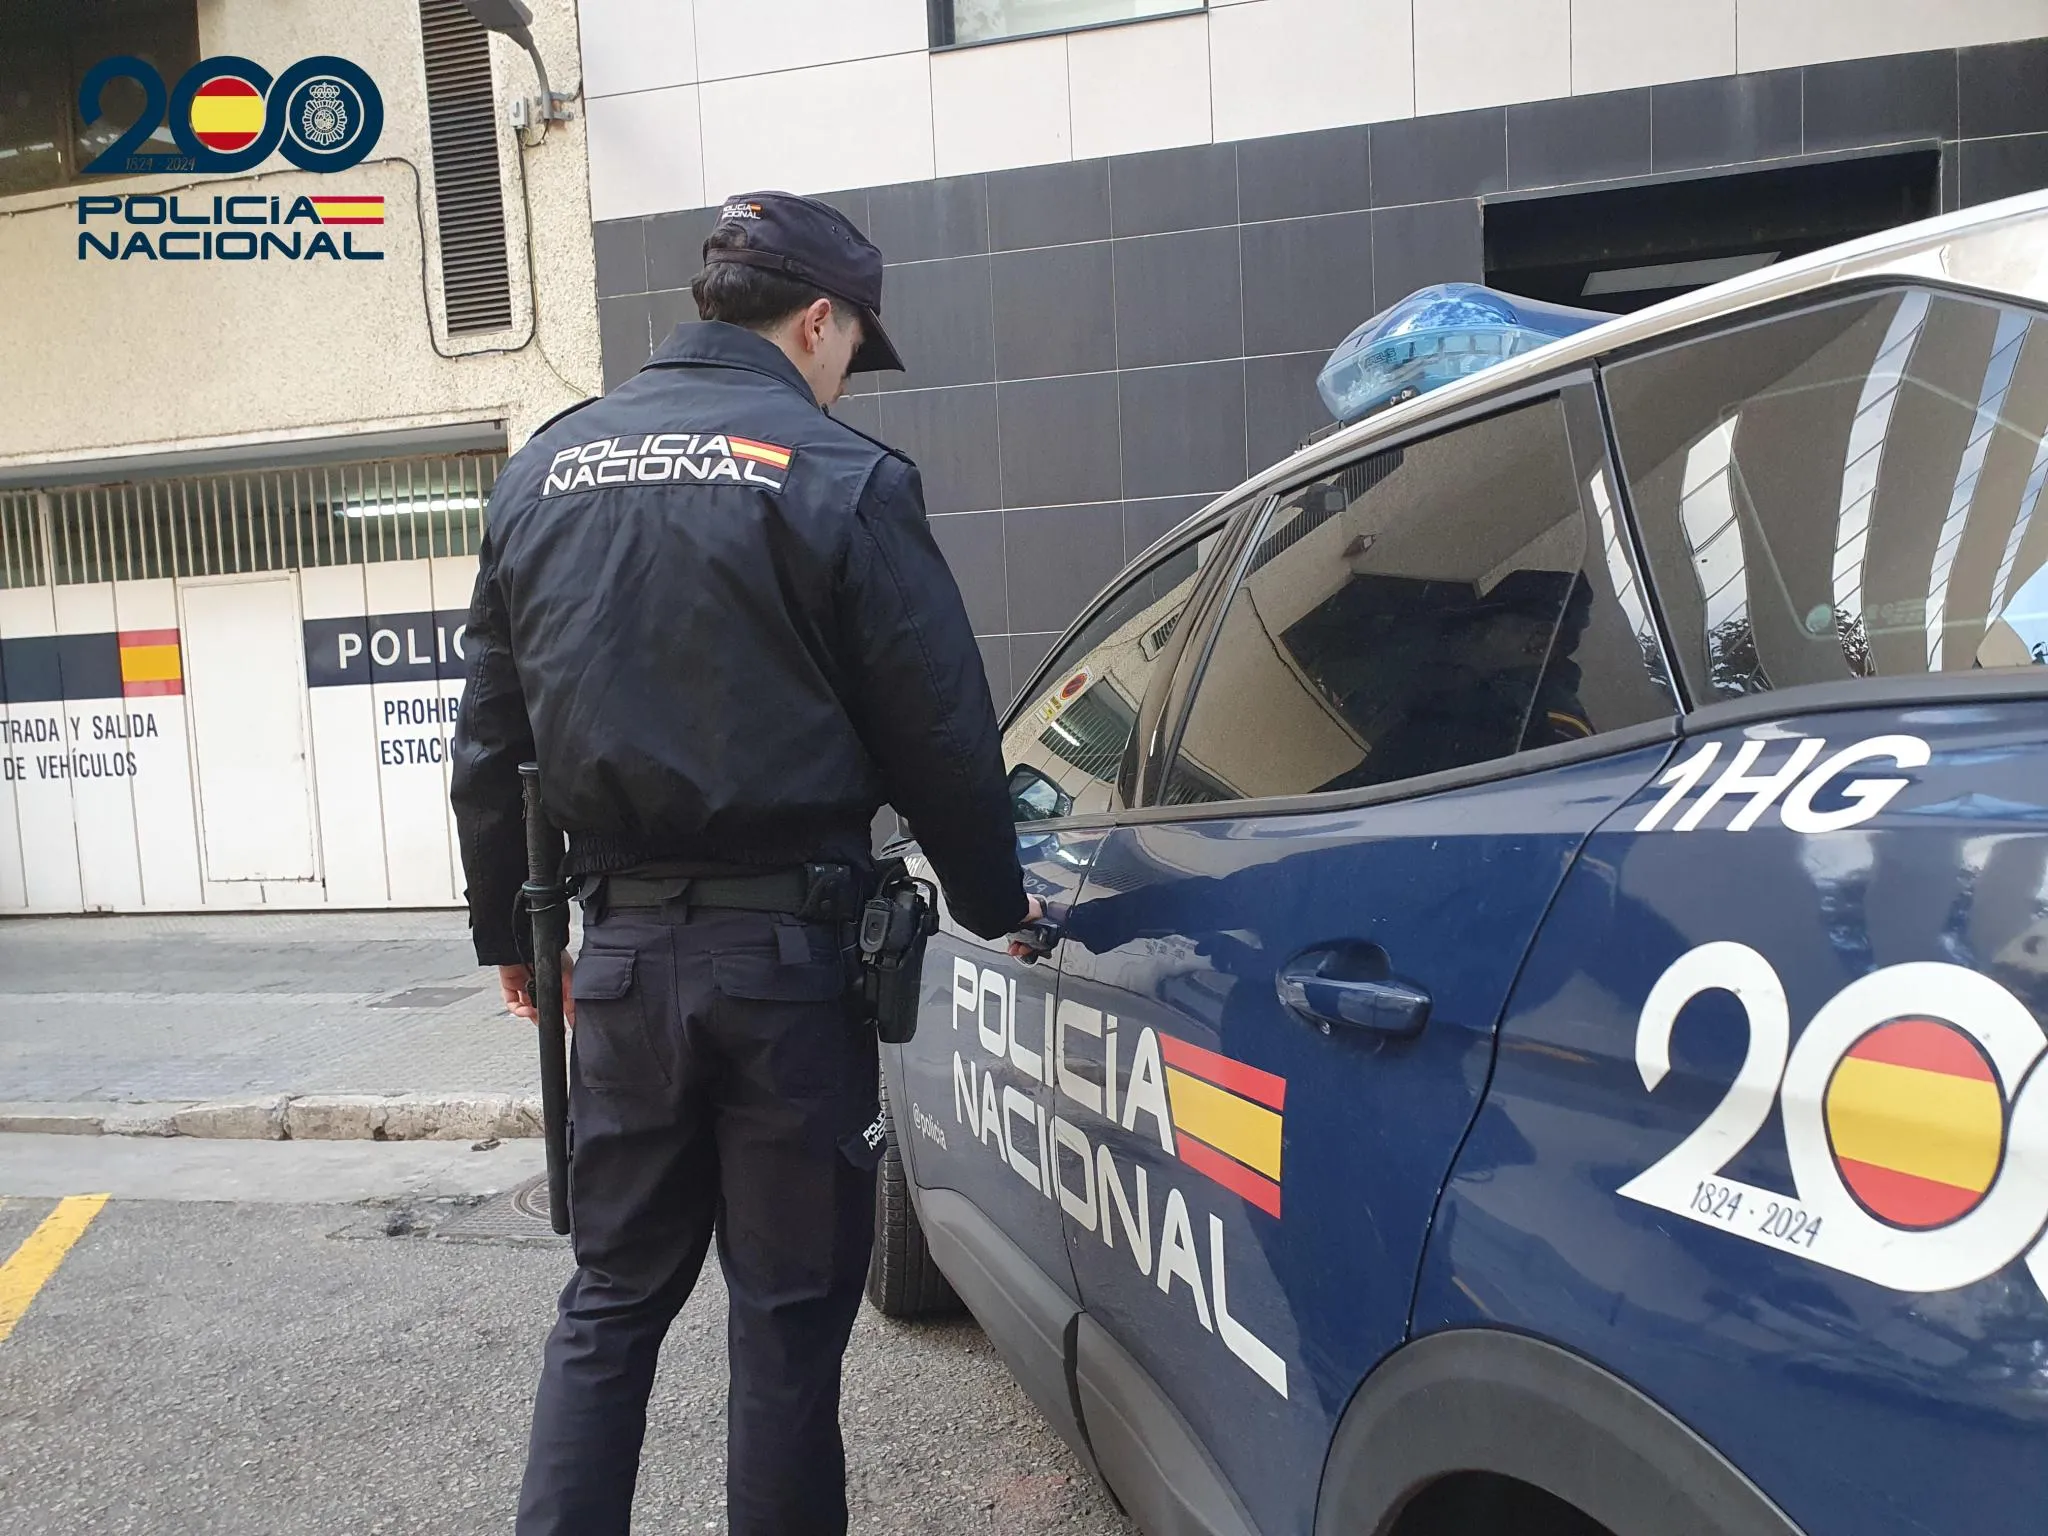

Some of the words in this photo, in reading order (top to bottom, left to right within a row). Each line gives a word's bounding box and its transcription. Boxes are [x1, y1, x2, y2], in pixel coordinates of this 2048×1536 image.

[542, 455, 782, 496] NACIONAL
[0, 717, 60, 744] TRADA
[70, 716, 81, 741] Y
[92, 713, 159, 740] SALIDA
[384, 697, 460, 726] PROHIB
[3, 756, 26, 781] DE
[36, 747, 138, 780] VEHÍCULOS
[1634, 733, 1931, 834] 1HG
[1616, 940, 2048, 1304] 20
[952, 1050, 1289, 1401] NACIONAL
[1689, 1180, 1743, 1221] 1824
[1758, 1202, 1823, 1248] 2024
